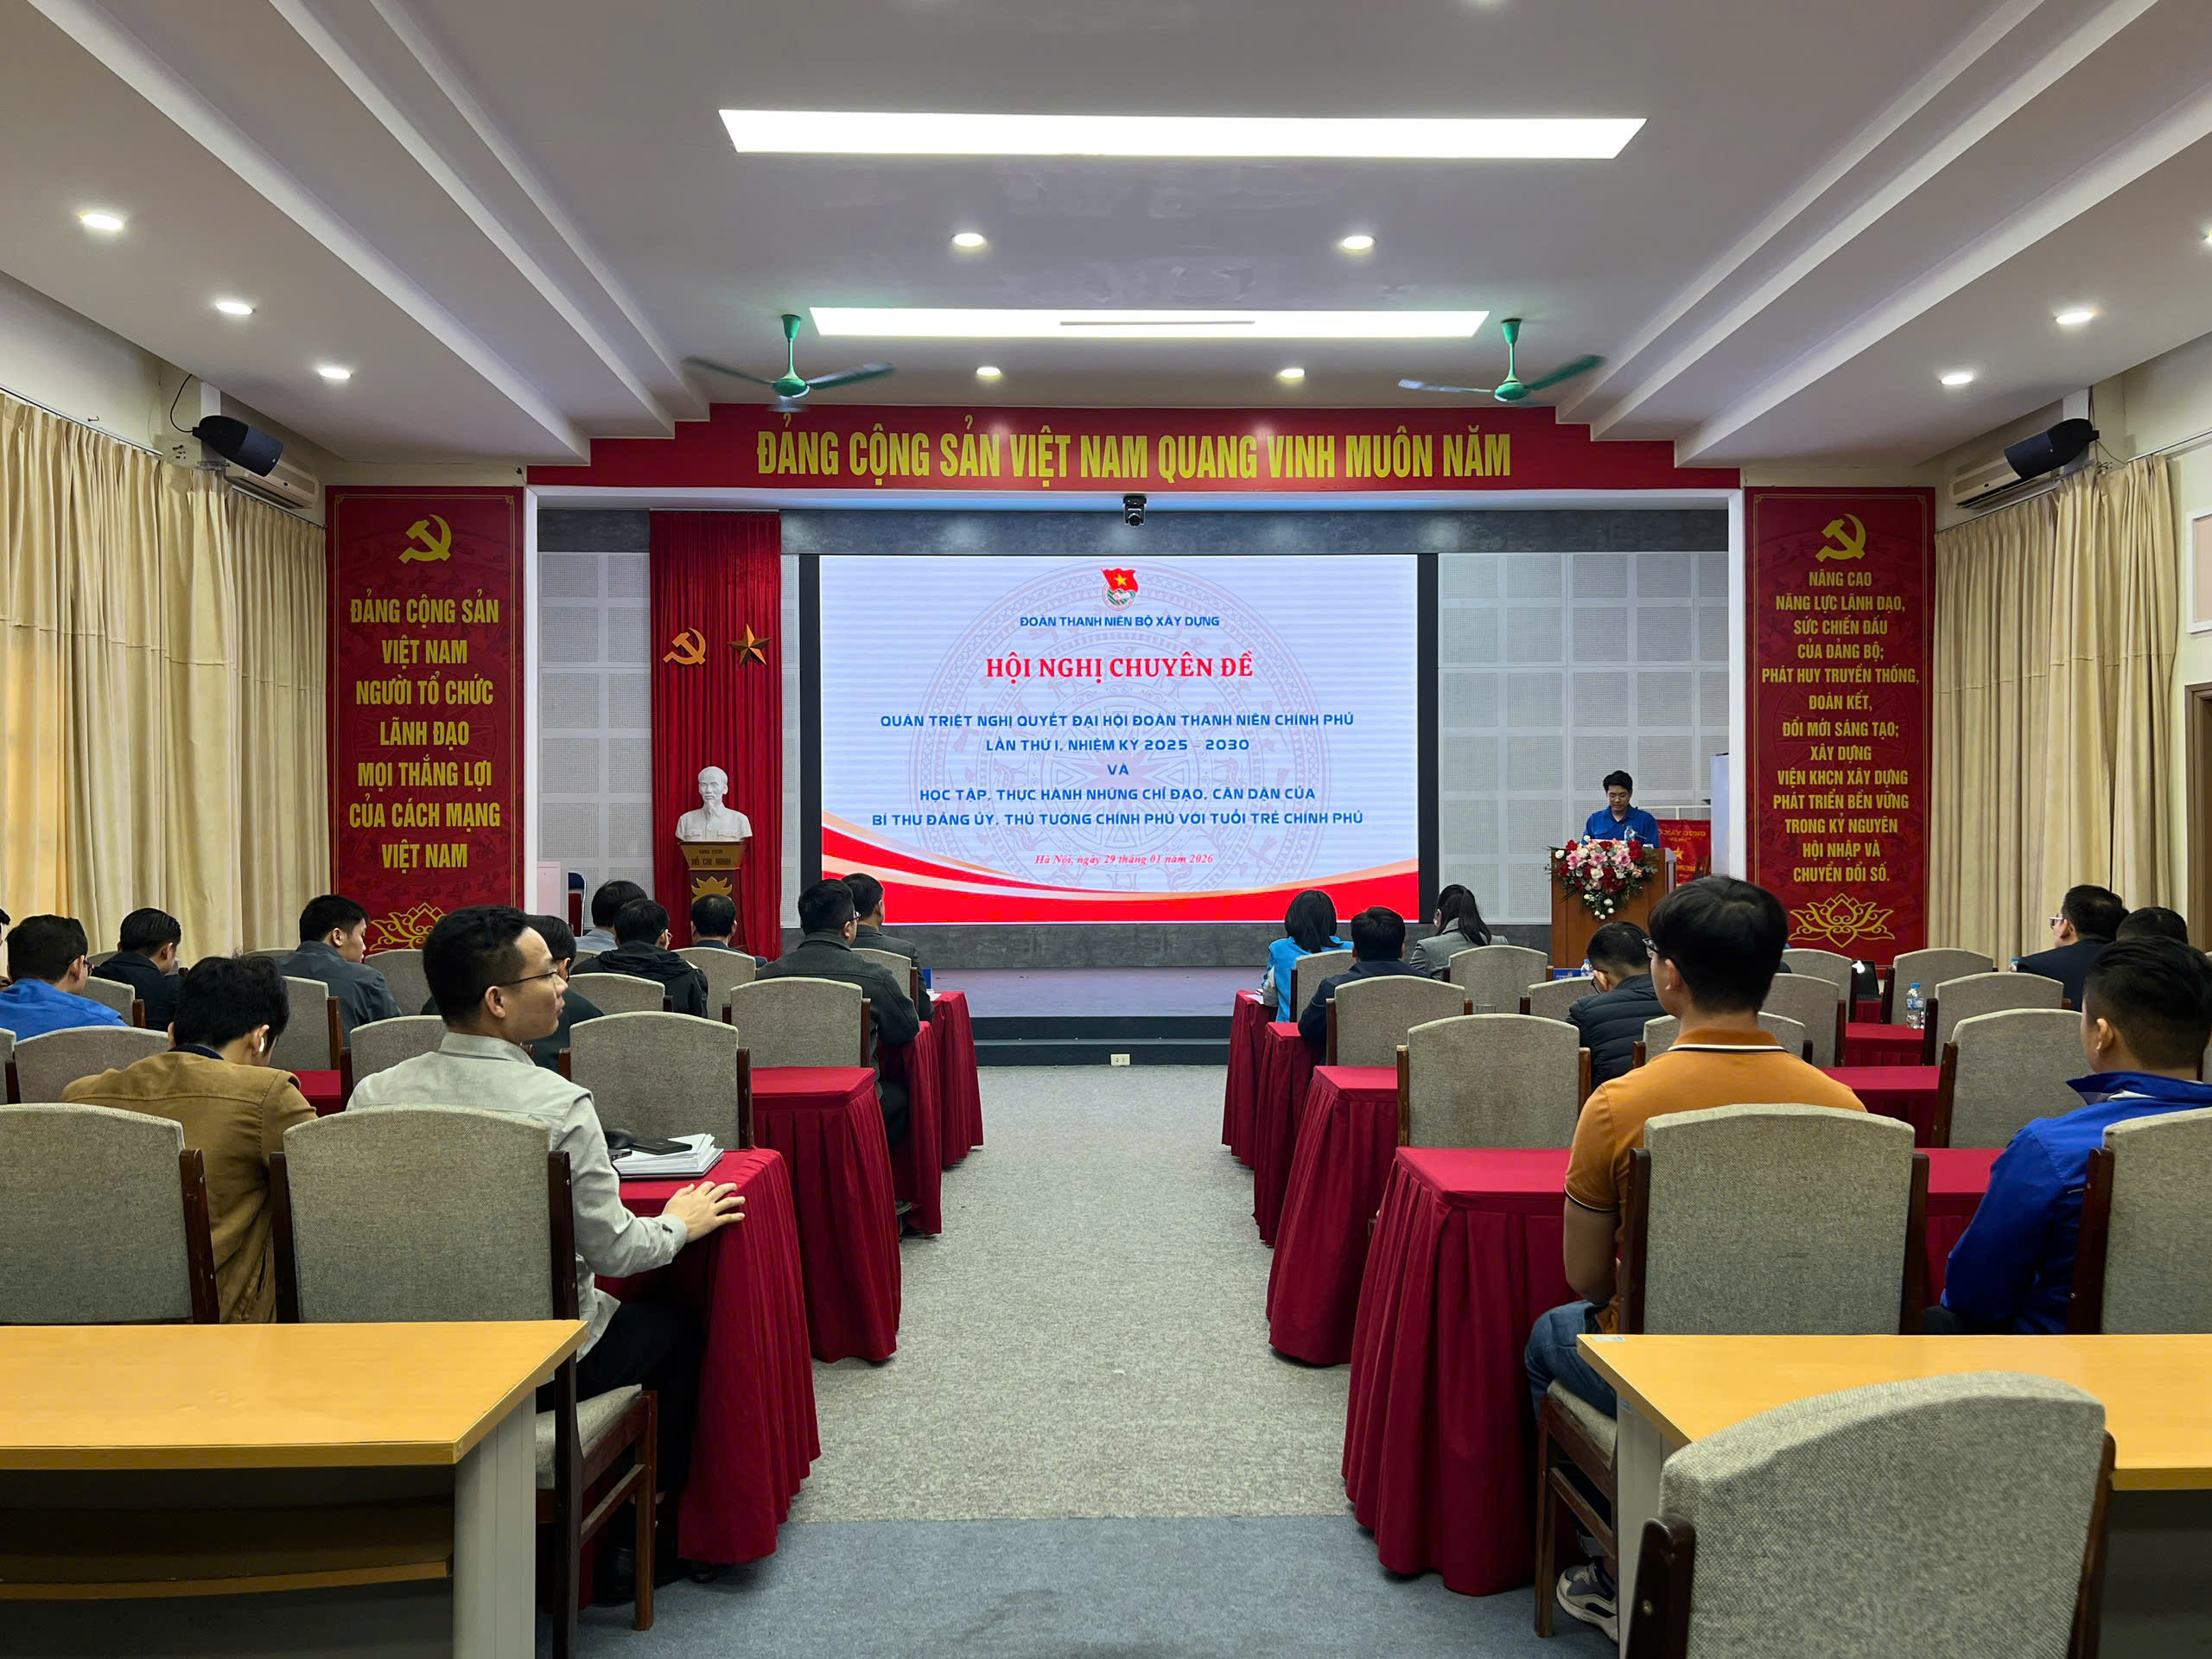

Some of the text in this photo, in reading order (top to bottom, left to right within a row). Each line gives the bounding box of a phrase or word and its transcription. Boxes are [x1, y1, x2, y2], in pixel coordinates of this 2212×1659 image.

[757, 413, 1510, 487] ĐẢNG CỘNG SẢN VIỆT NAM QUANG VINH MUÔN NĂM
[1809, 569, 1872, 587] NÂNG CAO
[351, 588, 499, 628] ĐẢNG CỘNG SẢN
[1776, 593, 1811, 610] NĂNG
[1815, 594, 1838, 613] LỰC
[1841, 594, 1873, 610] LÃNH
[1059, 616, 1103, 626] THANH
[1104, 615, 1133, 626] NIÊN
[1135, 614, 1154, 628] BỘ
[1794, 614, 1888, 634] SỨC CHIẾN ĐẤU
[382, 635, 467, 670] VIỆT NAM
[1797, 639, 1822, 659] CỦA
[1826, 639, 1860, 659] ĐẢNG
[987, 651, 1253, 684] HỘI NGHỊ CHUYÊN ĐỀ
[1762, 664, 1793, 683] PHÁT
[1797, 668, 1821, 683] HUY
[1825, 663, 1872, 683] TRUYỀN
[356, 671, 493, 704] NGƯỜI TỔ CHỨC
[1808, 692, 1843, 709] ĐOÀN
[1016, 711, 1068, 727] QUYẾT
[1071, 715, 1099, 727] ĐẠI
[1103, 714, 1128, 728] HỘI
[1181, 715, 1232, 727] THANH
[1236, 712, 1270, 726] NIÊN
[1323, 711, 1354, 726] PHỦ
[1783, 716, 1803, 736] ĐỔI
[1808, 718, 1831, 736] MỚI
[1834, 719, 1869, 737] SÁNG
[380, 716, 468, 750] LÃNH ĐẠO
[986, 736, 1016, 752] LẦN
[1068, 738, 1116, 751] NHIỆM
[1144, 739, 1188, 751] 2025
[1205, 739, 1249, 751] 2030
[1810, 743, 1872, 764] XÂY DỰNG
[359, 753, 491, 792] MỌI THẮNG LỢI
[1777, 767, 1909, 788] VIỆN KHCN XÂY DỰNG
[919, 789, 950, 803] HỌC
[995, 789, 1037, 803] THỰC
[1142, 787, 1166, 800] CHỈ
[1285, 785, 1316, 799] CỦA
[1773, 788, 1909, 809] PHÁT TRIỂN BỀN VỮNG
[349, 792, 500, 832] CỦA CÁCH MẠNG
[1004, 814, 1034, 825] THỦ
[1144, 811, 1175, 825] PHỦ
[1210, 808, 1246, 824] TUỔI
[1332, 812, 1363, 823] PHỦ
[1785, 813, 1897, 833] TRONG KỶ NGUYÊN
[382, 839, 467, 873] VIỆT NAM
[1034, 855, 1050, 864] Hà
[1077, 855, 1100, 866] ngày
[1104, 855, 1116, 864] 29
[1119, 855, 1147, 866] tháng
[1189, 854, 1213, 863] 2026
[1802, 839, 1881, 861] HỘI NHẬP VÀ
